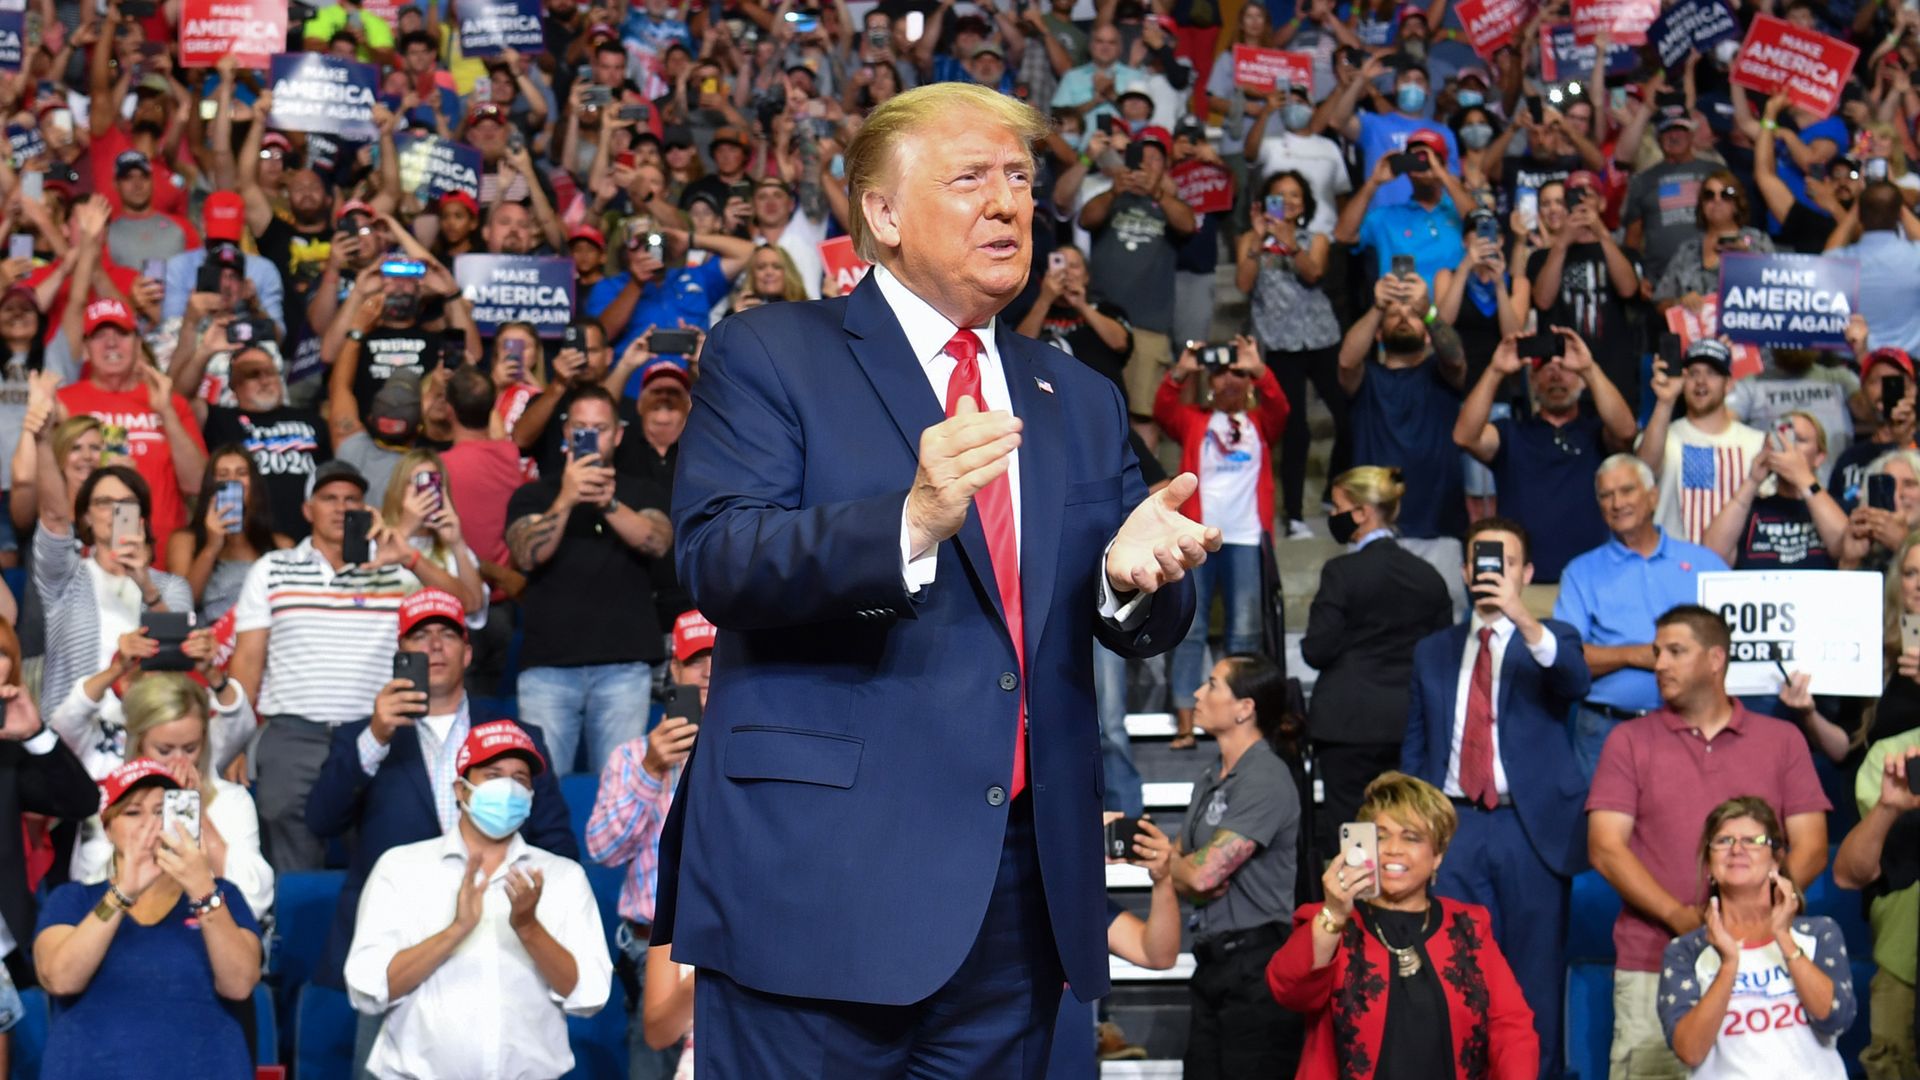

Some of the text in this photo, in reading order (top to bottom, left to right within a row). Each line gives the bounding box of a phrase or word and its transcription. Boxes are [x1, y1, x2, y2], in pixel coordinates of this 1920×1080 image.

[185, 19, 280, 38] AMERICA
[462, 15, 541, 36] AMERICA
[1658, 1, 1728, 56] AMERICA
[1781, 32, 1824, 60] MAKE
[302, 66, 349, 83] MAKE
[1746, 40, 1840, 89] AMERICA
[273, 79, 376, 105] AMERICA
[1741, 59, 1834, 103] GREAT AGAIN
[492, 268, 539, 284] MAKE
[1761, 267, 1817, 287] MAKE
[462, 284, 570, 307] AMERICA
[1724, 286, 1850, 314] AMERICA
[87, 299, 127, 320] USA
[471, 305, 571, 325] REAT AGAIN
[1722, 311, 1786, 331] GREAT
[1766, 388, 1832, 405] TRUMP
[89, 411, 164, 429] UMP
[254, 450, 316, 475] 2020
[1720, 602, 1796, 633] COPS
[1724, 1003, 1808, 1037] 2020
